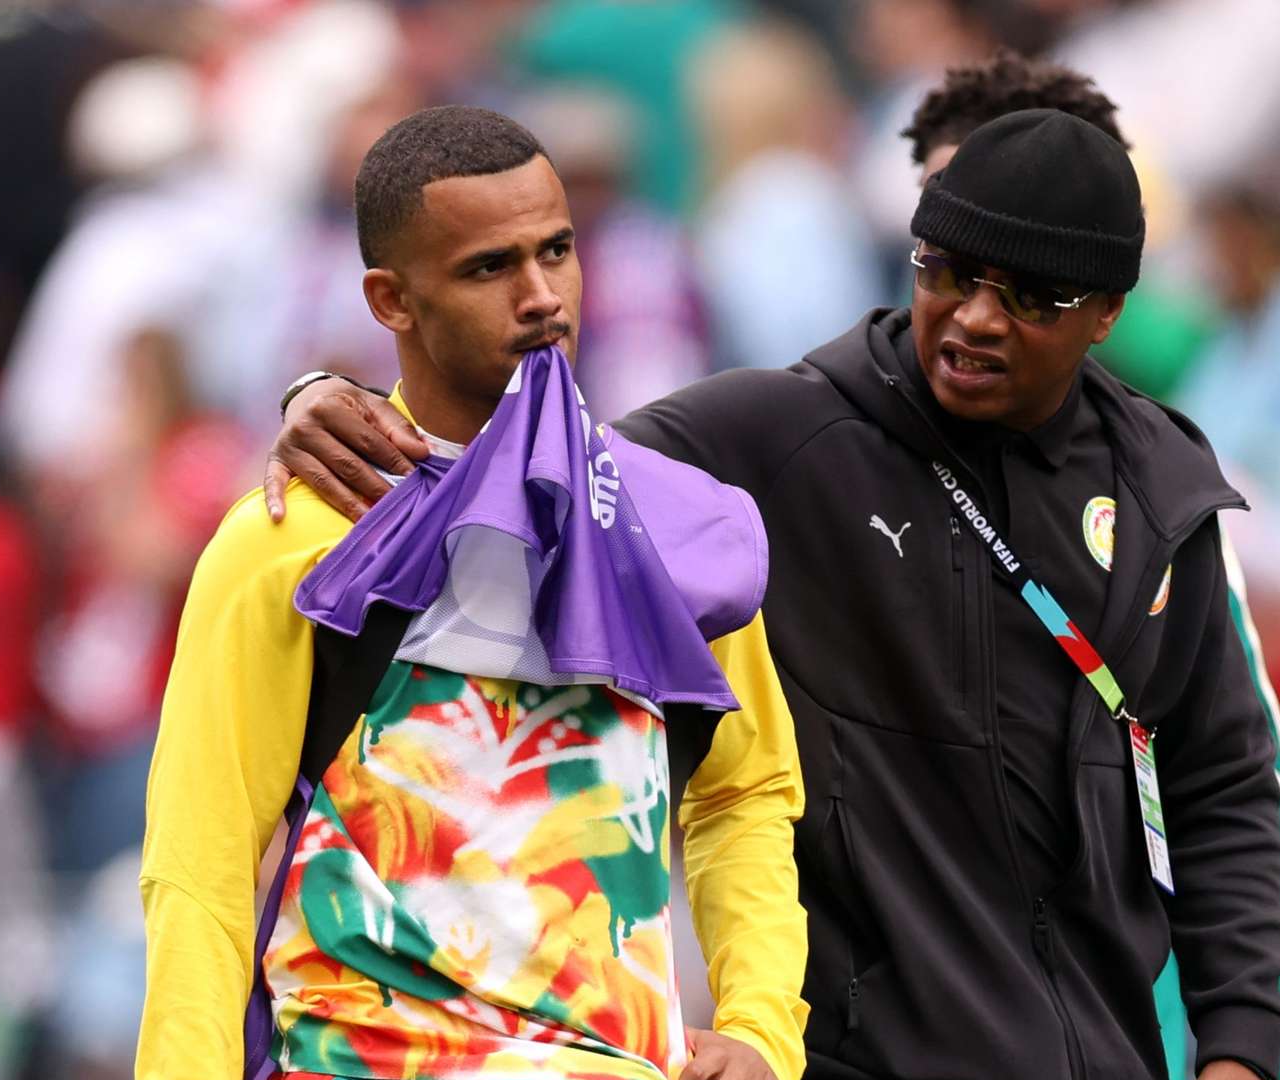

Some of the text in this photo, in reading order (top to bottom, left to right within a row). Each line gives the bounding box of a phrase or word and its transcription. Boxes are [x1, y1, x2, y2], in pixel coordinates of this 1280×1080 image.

[593, 450, 620, 530] CUP
[952, 489, 996, 544] WORLD
[992, 538, 1020, 573] FIFA
